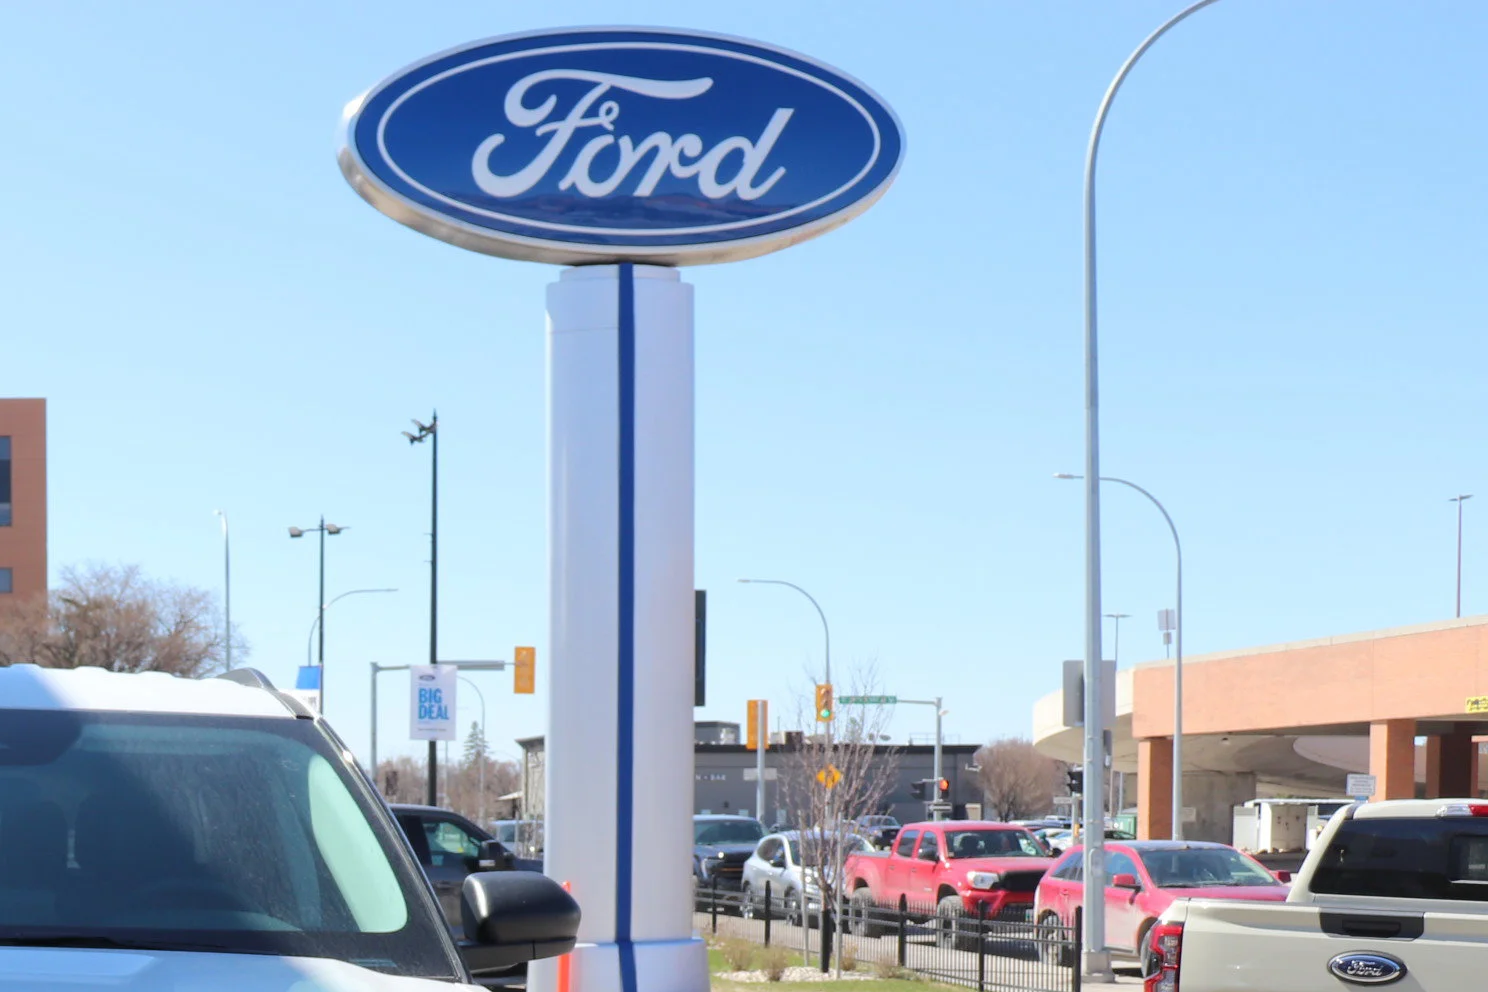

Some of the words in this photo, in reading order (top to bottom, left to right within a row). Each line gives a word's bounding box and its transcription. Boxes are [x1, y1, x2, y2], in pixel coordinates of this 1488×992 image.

[471, 68, 796, 201] Ford
[418, 687, 442, 703] BIG
[418, 703, 450, 720] DEAL
[1346, 959, 1384, 977] Ford
